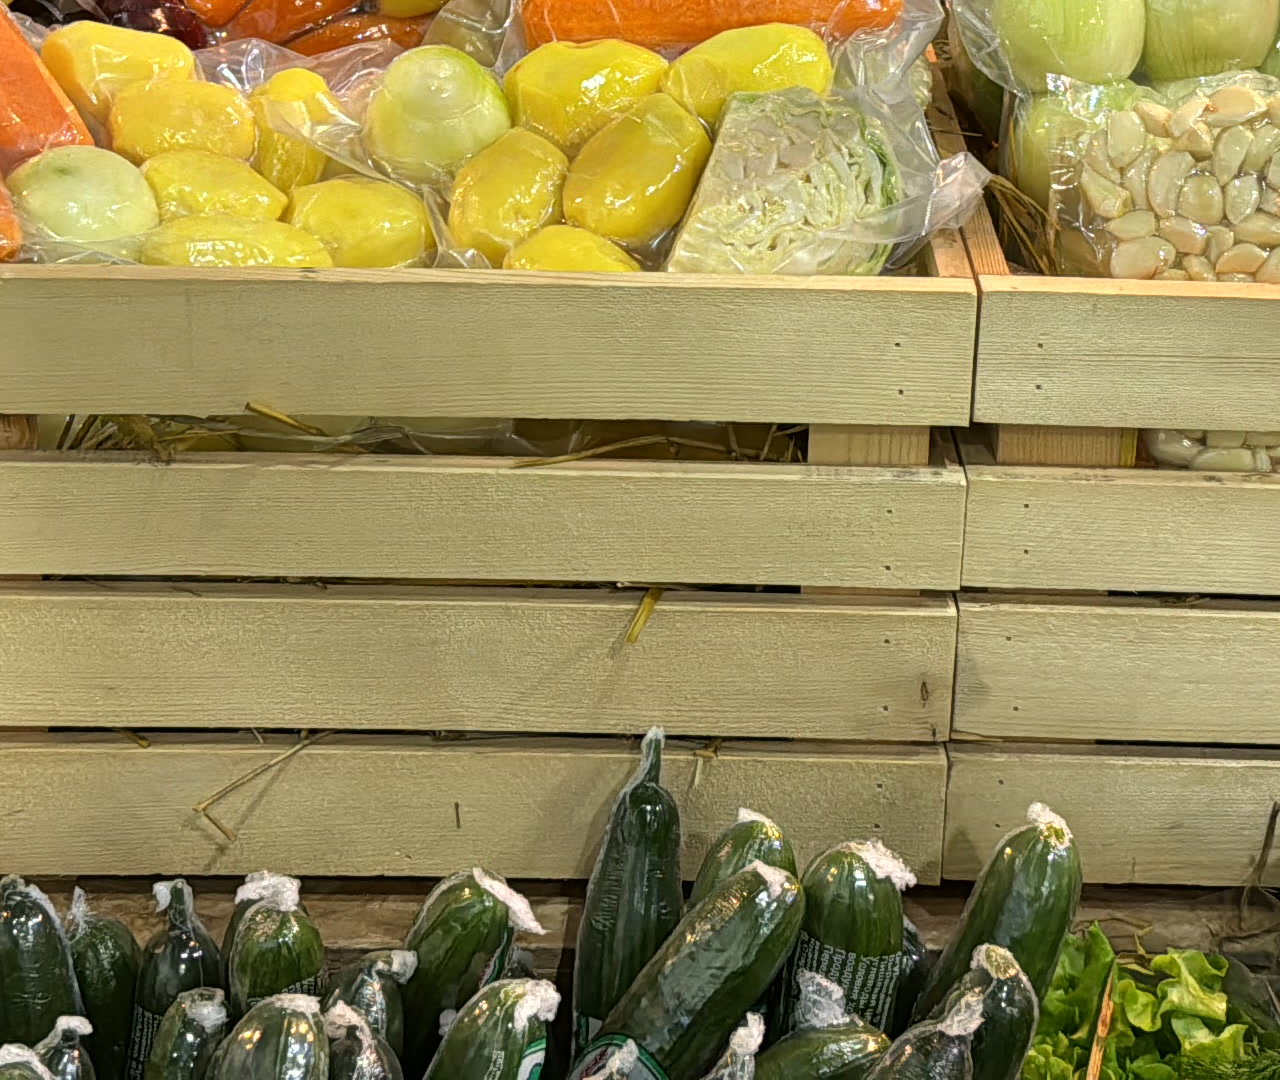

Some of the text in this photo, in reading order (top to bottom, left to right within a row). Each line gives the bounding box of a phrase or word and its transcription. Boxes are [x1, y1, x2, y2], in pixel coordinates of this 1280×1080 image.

[828, 948, 846, 983] Проду
[850, 955, 871, 1000] Условия
[859, 956, 880, 1008] углеводы
[870, 955, 889, 1007] Пищевая
